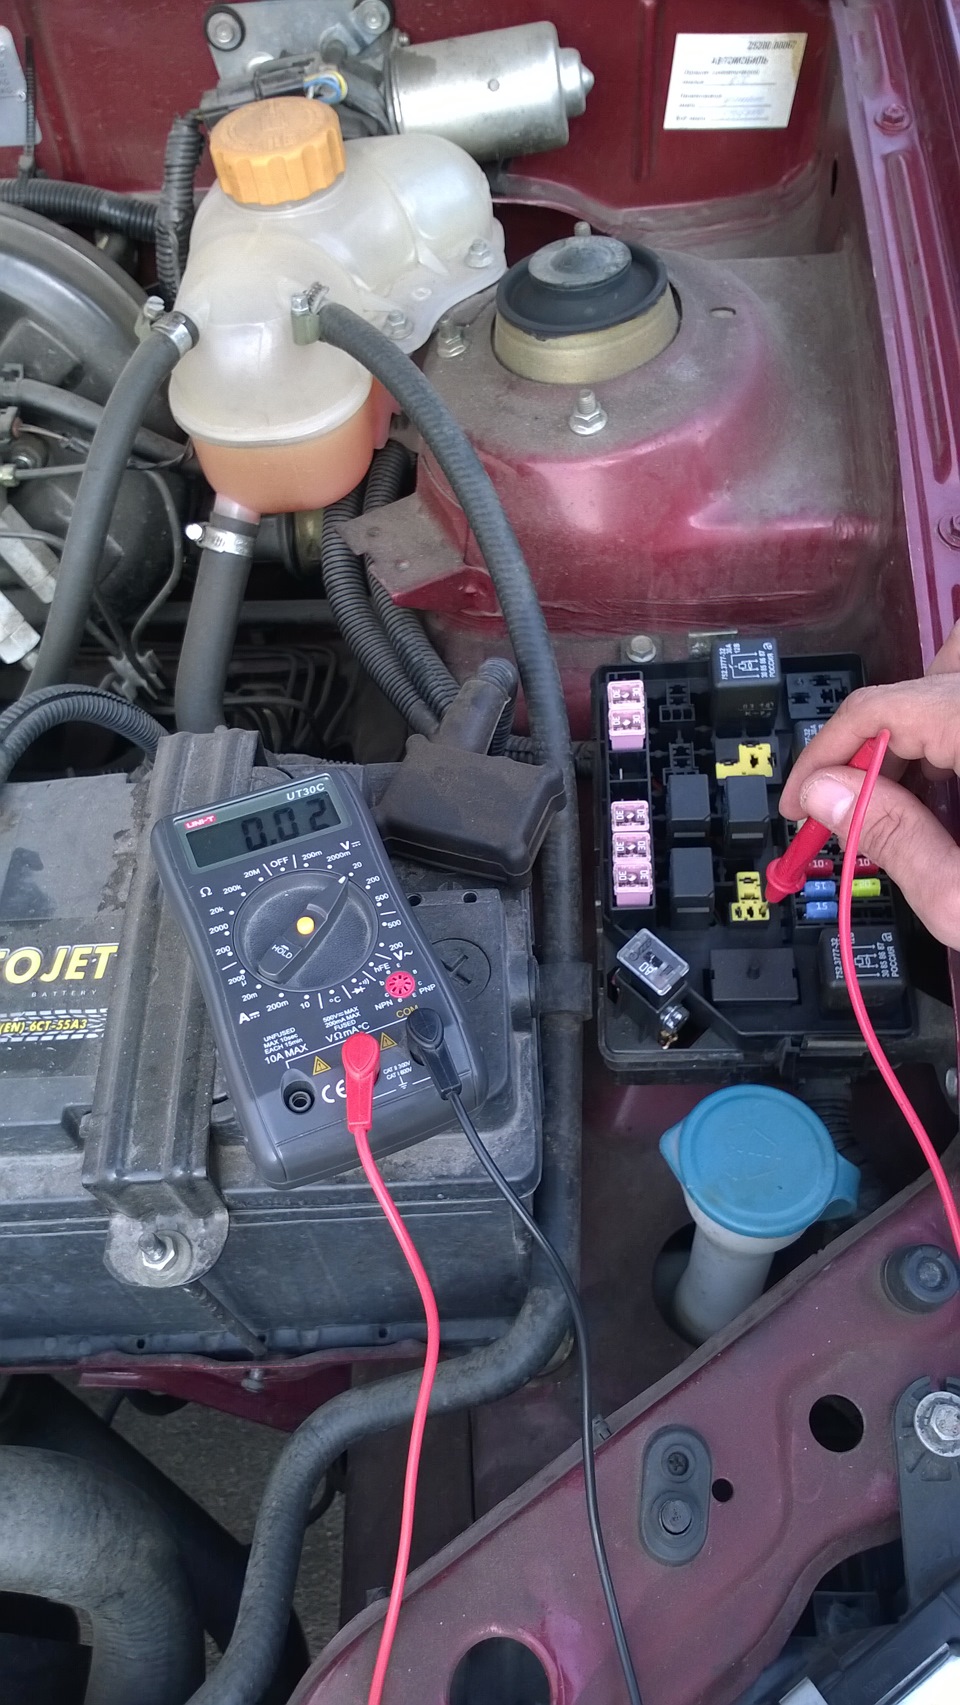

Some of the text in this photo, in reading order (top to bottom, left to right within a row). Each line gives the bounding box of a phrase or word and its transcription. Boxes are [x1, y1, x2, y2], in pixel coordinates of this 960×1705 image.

[287, 783, 325, 800] UT30C
[186, 815, 214, 828] UNI-T
[241, 798, 331, 850] 0.02
[302, 850, 322, 860] 200m
[326, 850, 351, 862] 2000m
[270, 856, 288, 868] OFF
[812, 860, 824, 868] 10
[858, 858, 870, 866] 10
[244, 868, 260, 878] 20M
[366, 876, 380, 884] 200
[223, 884, 242, 894] 200k
[375, 893, 389, 902] 500
[210, 906, 224, 915] 20k
[816, 902, 828, 910] 15
[209, 923, 228, 934] 2000
[388, 920, 401, 928] 500
[216, 946, 230, 956] 200
[272, 944, 292, 959] HOLD
[389, 942, 403, 951] 200
[887, 946, 900, 978] РОССИЯ
[374, 962, 390, 973] hFE
[228, 975, 246, 985] 2000
[31, 990, 96, 998] BATTERY
[418, 984, 436, 994] PNP
[242, 992, 258, 1002] 20m
[266, 1000, 289, 1012] 200m
[300, 1001, 310, 1010] 10
[374, 999, 394, 1010] NPN
[344, 1006, 359, 1014] MAX
[346, 1012, 361, 1020] MAX
[334, 1020, 356, 1031] FUSED
[263, 1027, 296, 1042] UNFUSED
[264, 1040, 280, 1048] MAX
[264, 1038, 303, 1054] EACH 15min
[264, 1044, 308, 1064] 10A MAX
